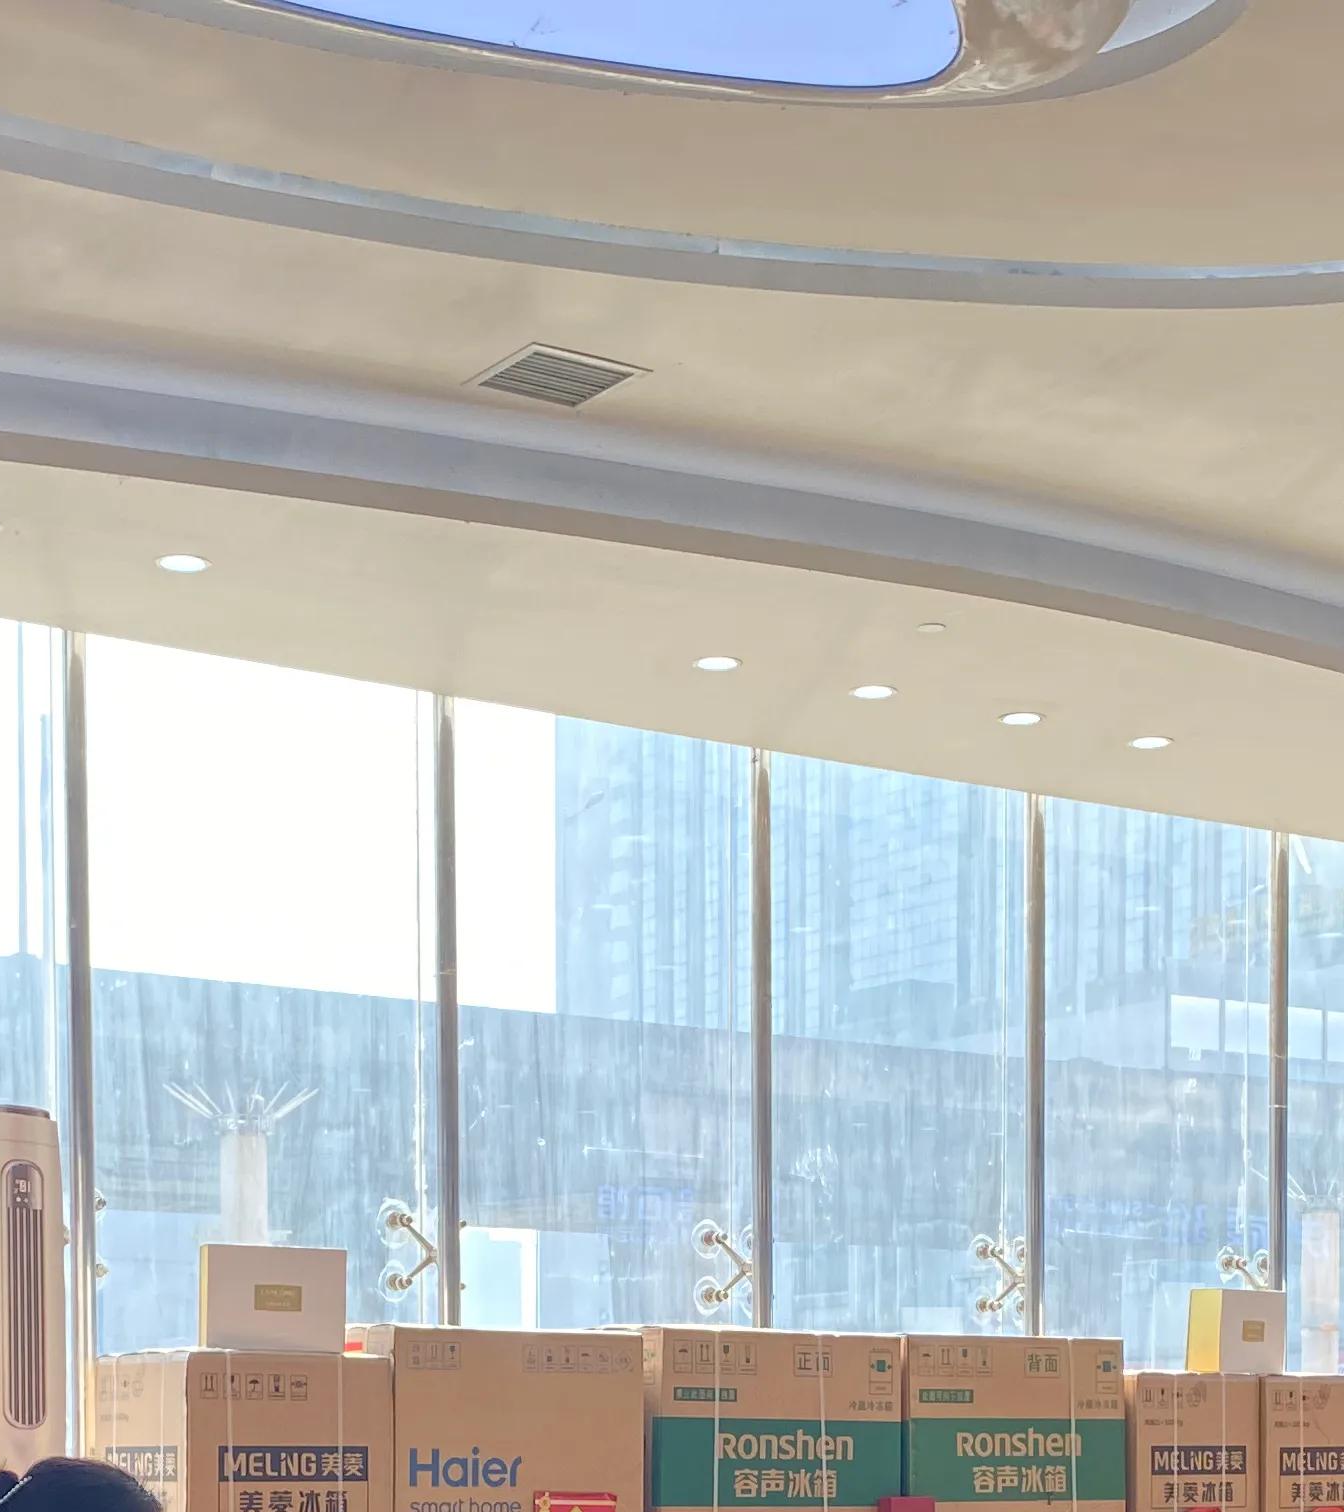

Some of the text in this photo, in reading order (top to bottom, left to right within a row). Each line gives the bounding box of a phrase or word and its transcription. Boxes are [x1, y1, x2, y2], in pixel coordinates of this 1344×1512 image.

[797, 1351, 830, 1372] 正面
[1027, 1353, 1058, 1373] 背面
[718, 1429, 854, 1461] Ronshen
[956, 1427, 1083, 1458] Ronshen
[409, 1446, 522, 1488] Haier
[972, 1465, 1067, 1493] 容声冰箱
[734, 1468, 838, 1498] 容声冰箱
[1163, 1481, 1233, 1504] 美菱冰箱
